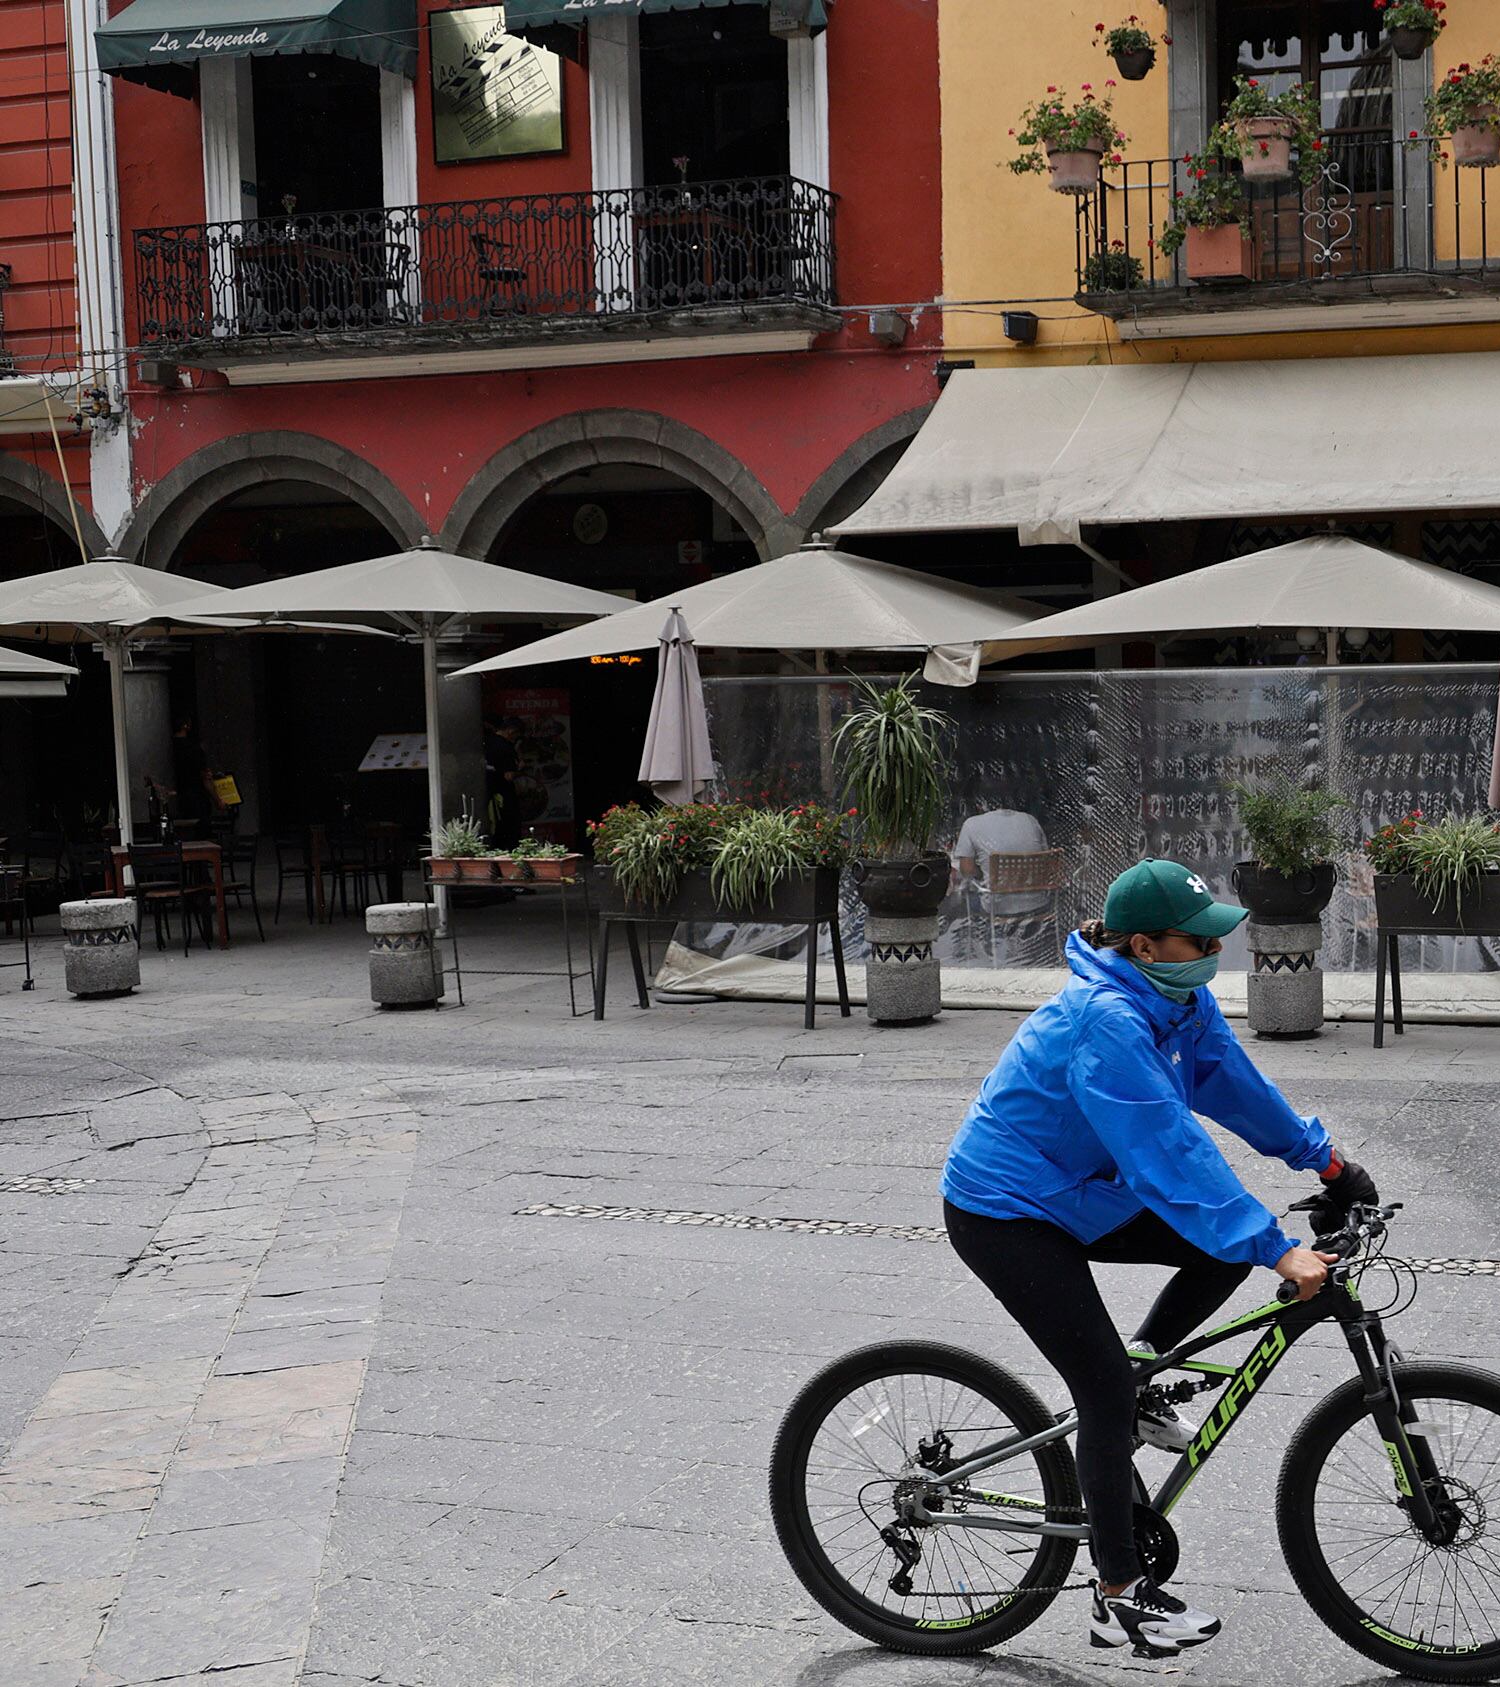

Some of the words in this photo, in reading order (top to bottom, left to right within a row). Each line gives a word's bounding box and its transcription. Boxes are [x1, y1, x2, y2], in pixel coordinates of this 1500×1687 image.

[149, 32, 181, 52] La
[186, 27, 269, 52] Leyenda
[462, 13, 506, 66] Leyend
[1187, 1324, 1287, 1469] HUFFY
[1416, 1642, 1481, 1655] ALLOY
